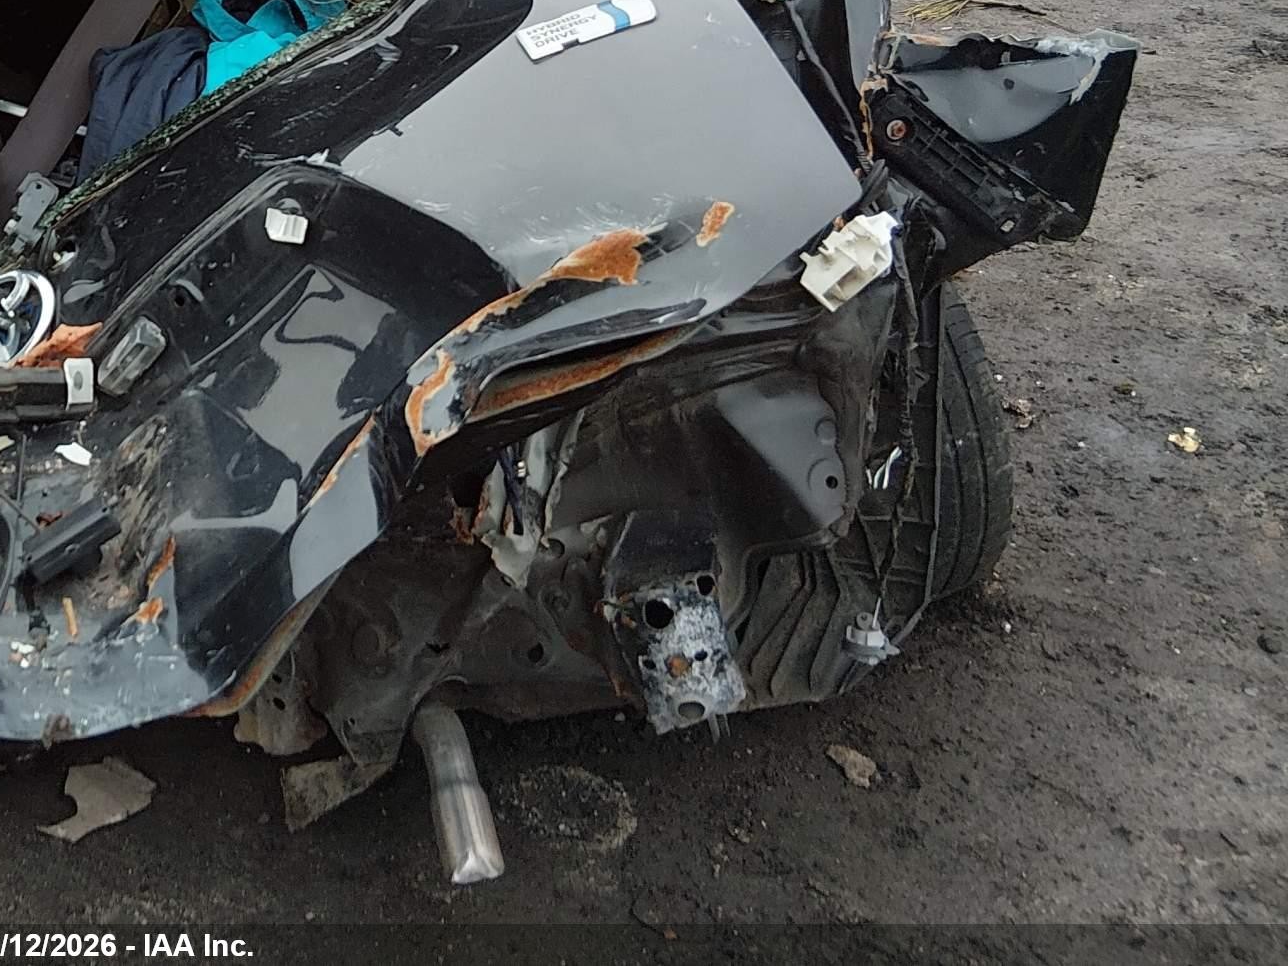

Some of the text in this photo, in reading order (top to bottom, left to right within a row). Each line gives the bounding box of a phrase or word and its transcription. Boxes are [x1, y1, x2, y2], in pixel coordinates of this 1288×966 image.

[526, 14, 580, 35] HYBRID
[531, 15, 596, 41] SYNERGY
[535, 28, 578, 48] DRIVE
